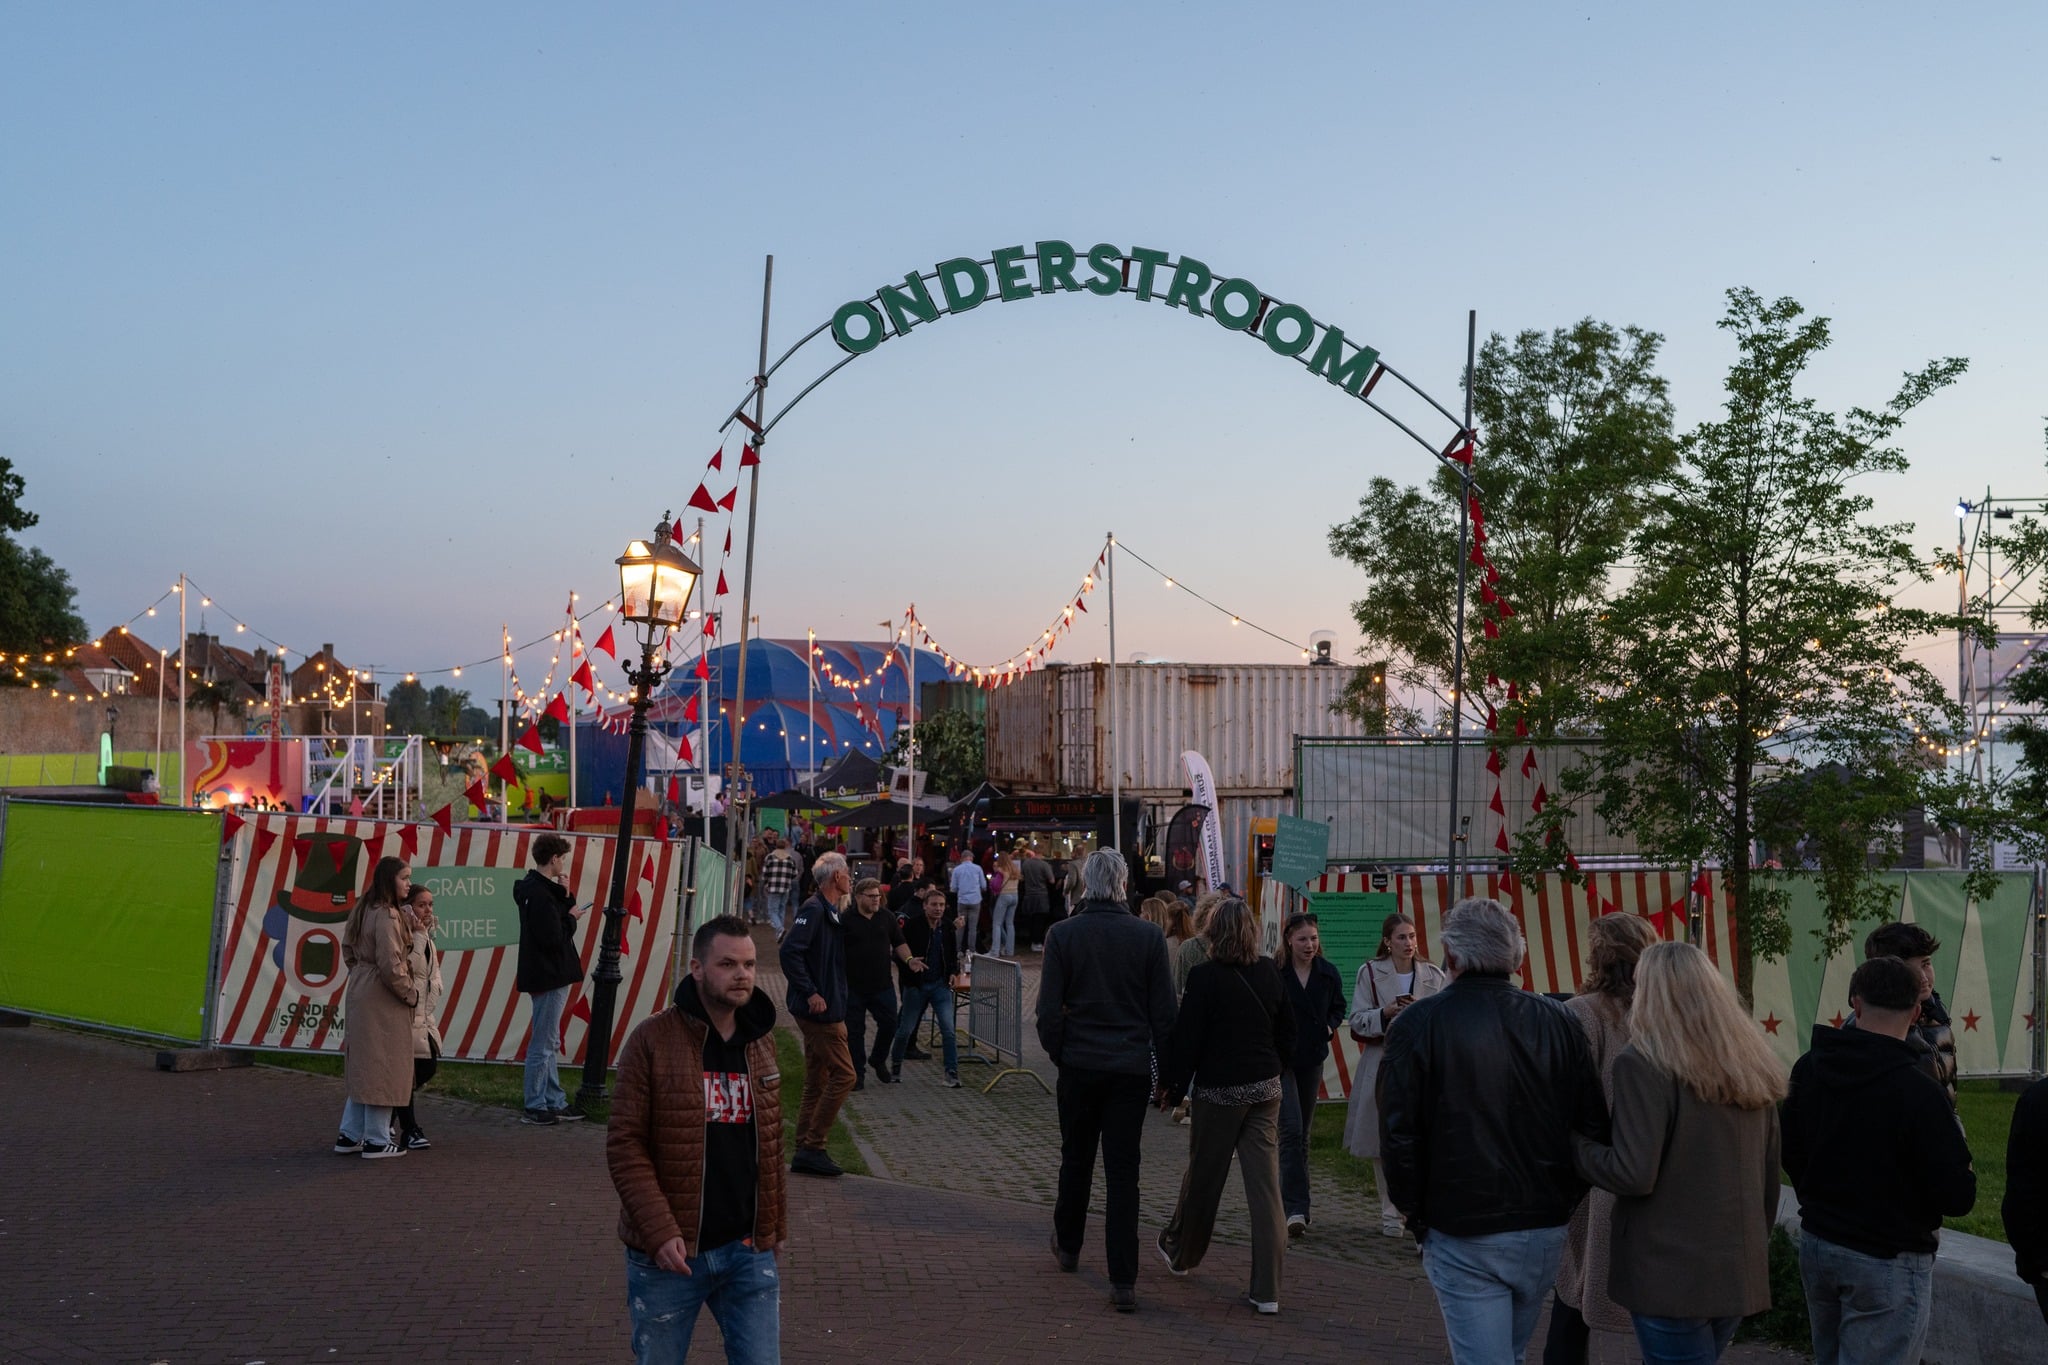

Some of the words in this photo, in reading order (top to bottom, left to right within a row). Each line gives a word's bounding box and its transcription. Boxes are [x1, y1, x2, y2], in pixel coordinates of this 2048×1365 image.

[831, 239, 1381, 397] ONDERSTROOM
[271, 664, 280, 741] KARAOKE
[424, 876, 496, 897] GRATIS
[433, 918, 497, 939] NTREE
[287, 1002, 340, 1017] ONDER
[280, 1014, 344, 1030] STROOM
[280, 1027, 342, 1038] FSTIVAL
[703, 1078, 751, 1111] IESEL
